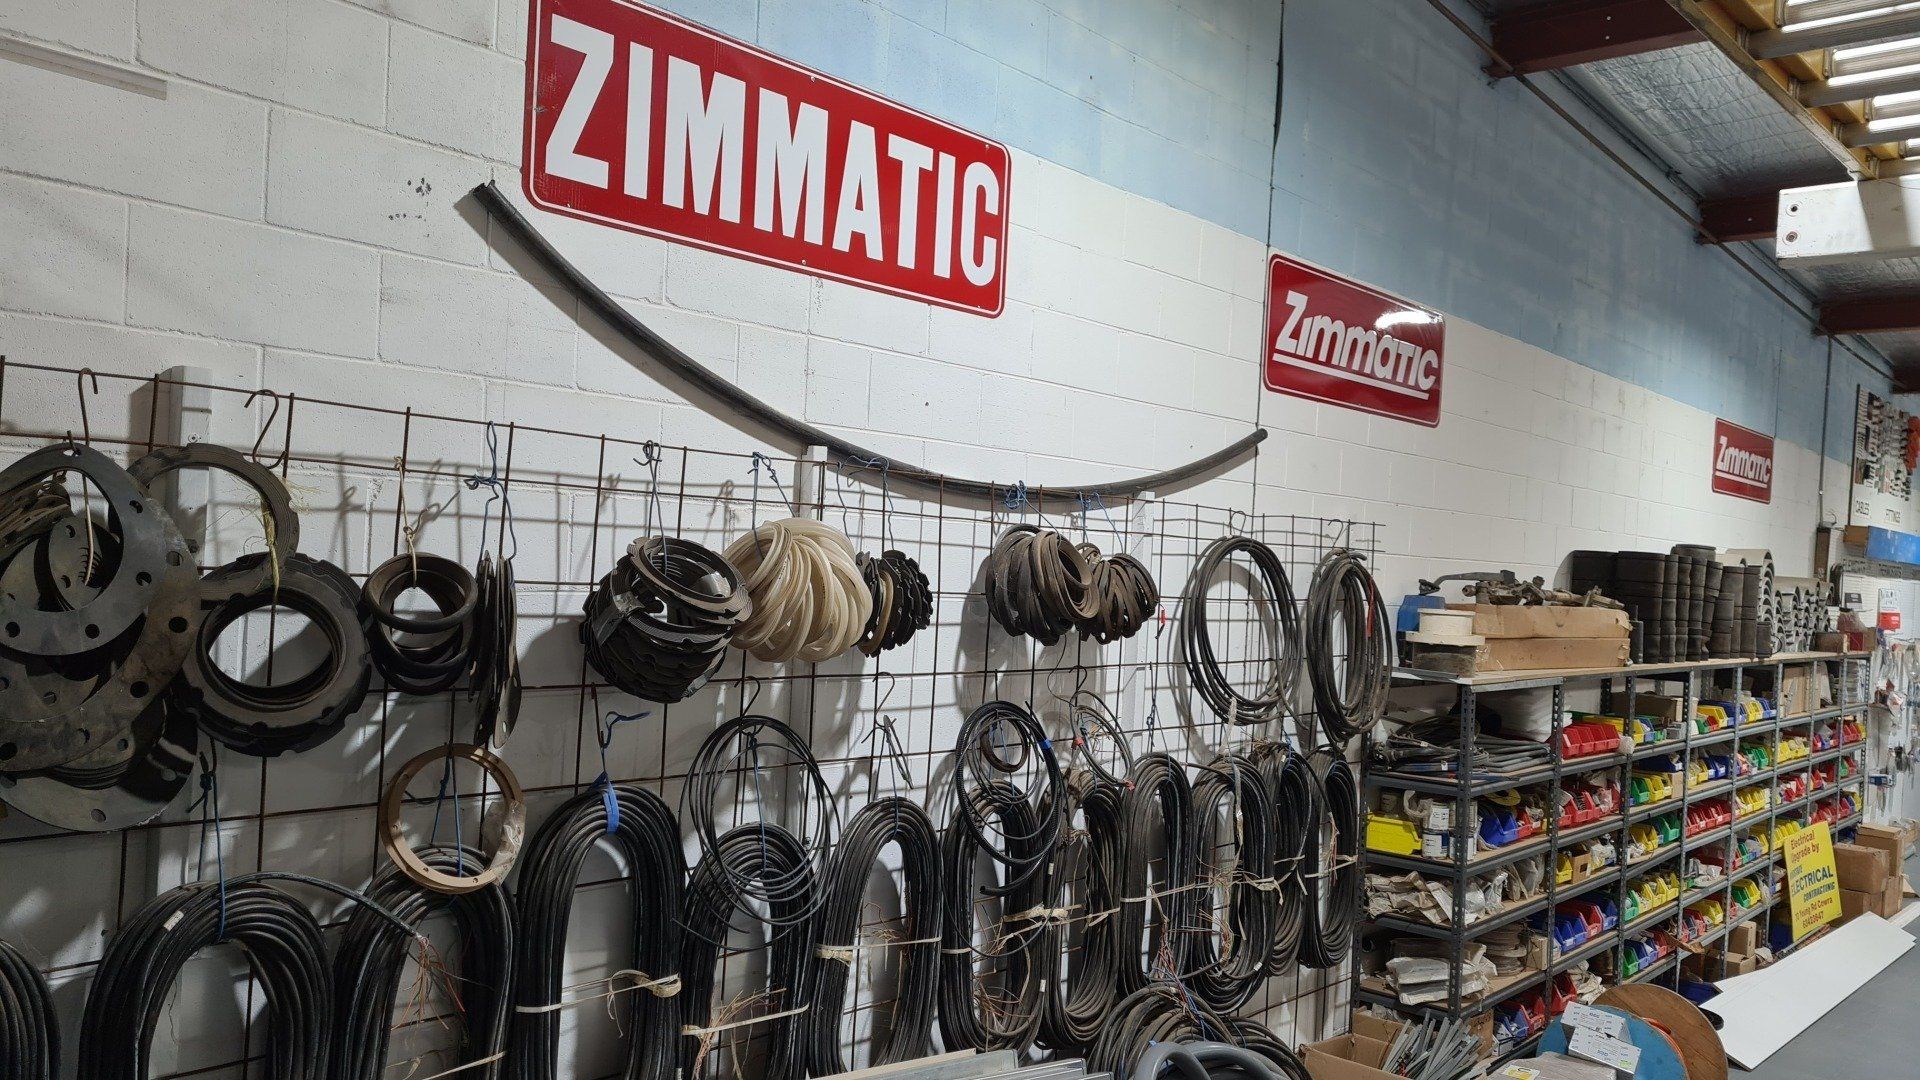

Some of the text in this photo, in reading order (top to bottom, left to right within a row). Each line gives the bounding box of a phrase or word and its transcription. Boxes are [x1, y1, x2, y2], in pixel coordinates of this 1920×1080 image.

[545, 13, 1000, 287] ZIMMATIC
[1790, 830, 1815, 850] Electrical
[1811, 842, 1820, 853] by
[1790, 866, 1834, 897] ELECTRICAL
